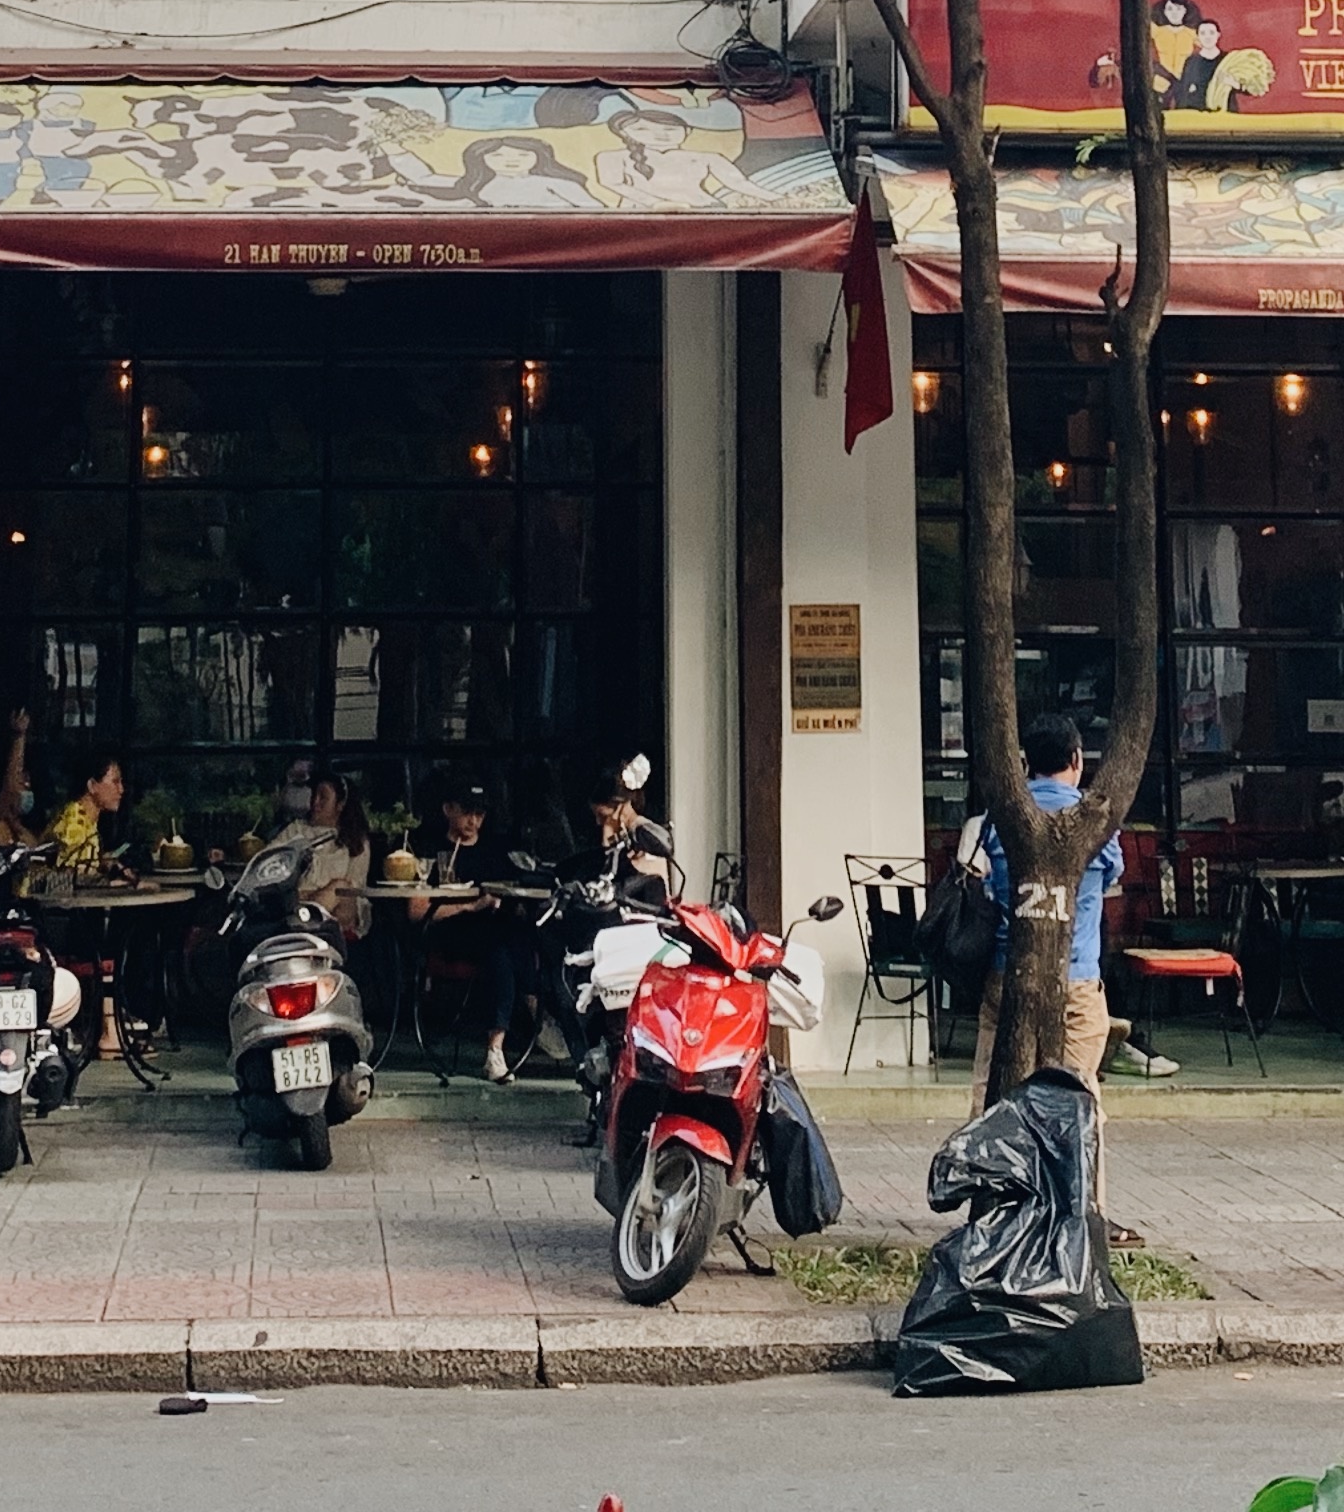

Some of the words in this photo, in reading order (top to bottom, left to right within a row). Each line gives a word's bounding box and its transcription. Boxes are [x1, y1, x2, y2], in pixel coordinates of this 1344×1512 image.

[224, 244, 241, 264] 21
[249, 244, 281, 264] HAN
[288, 243, 349, 264] THUYEN
[372, 244, 413, 264] OPEN
[1257, 289, 1344, 310] PROPAGANDA
[1014, 882, 1071, 922] 21
[282, 1066, 322, 1088] 8742
